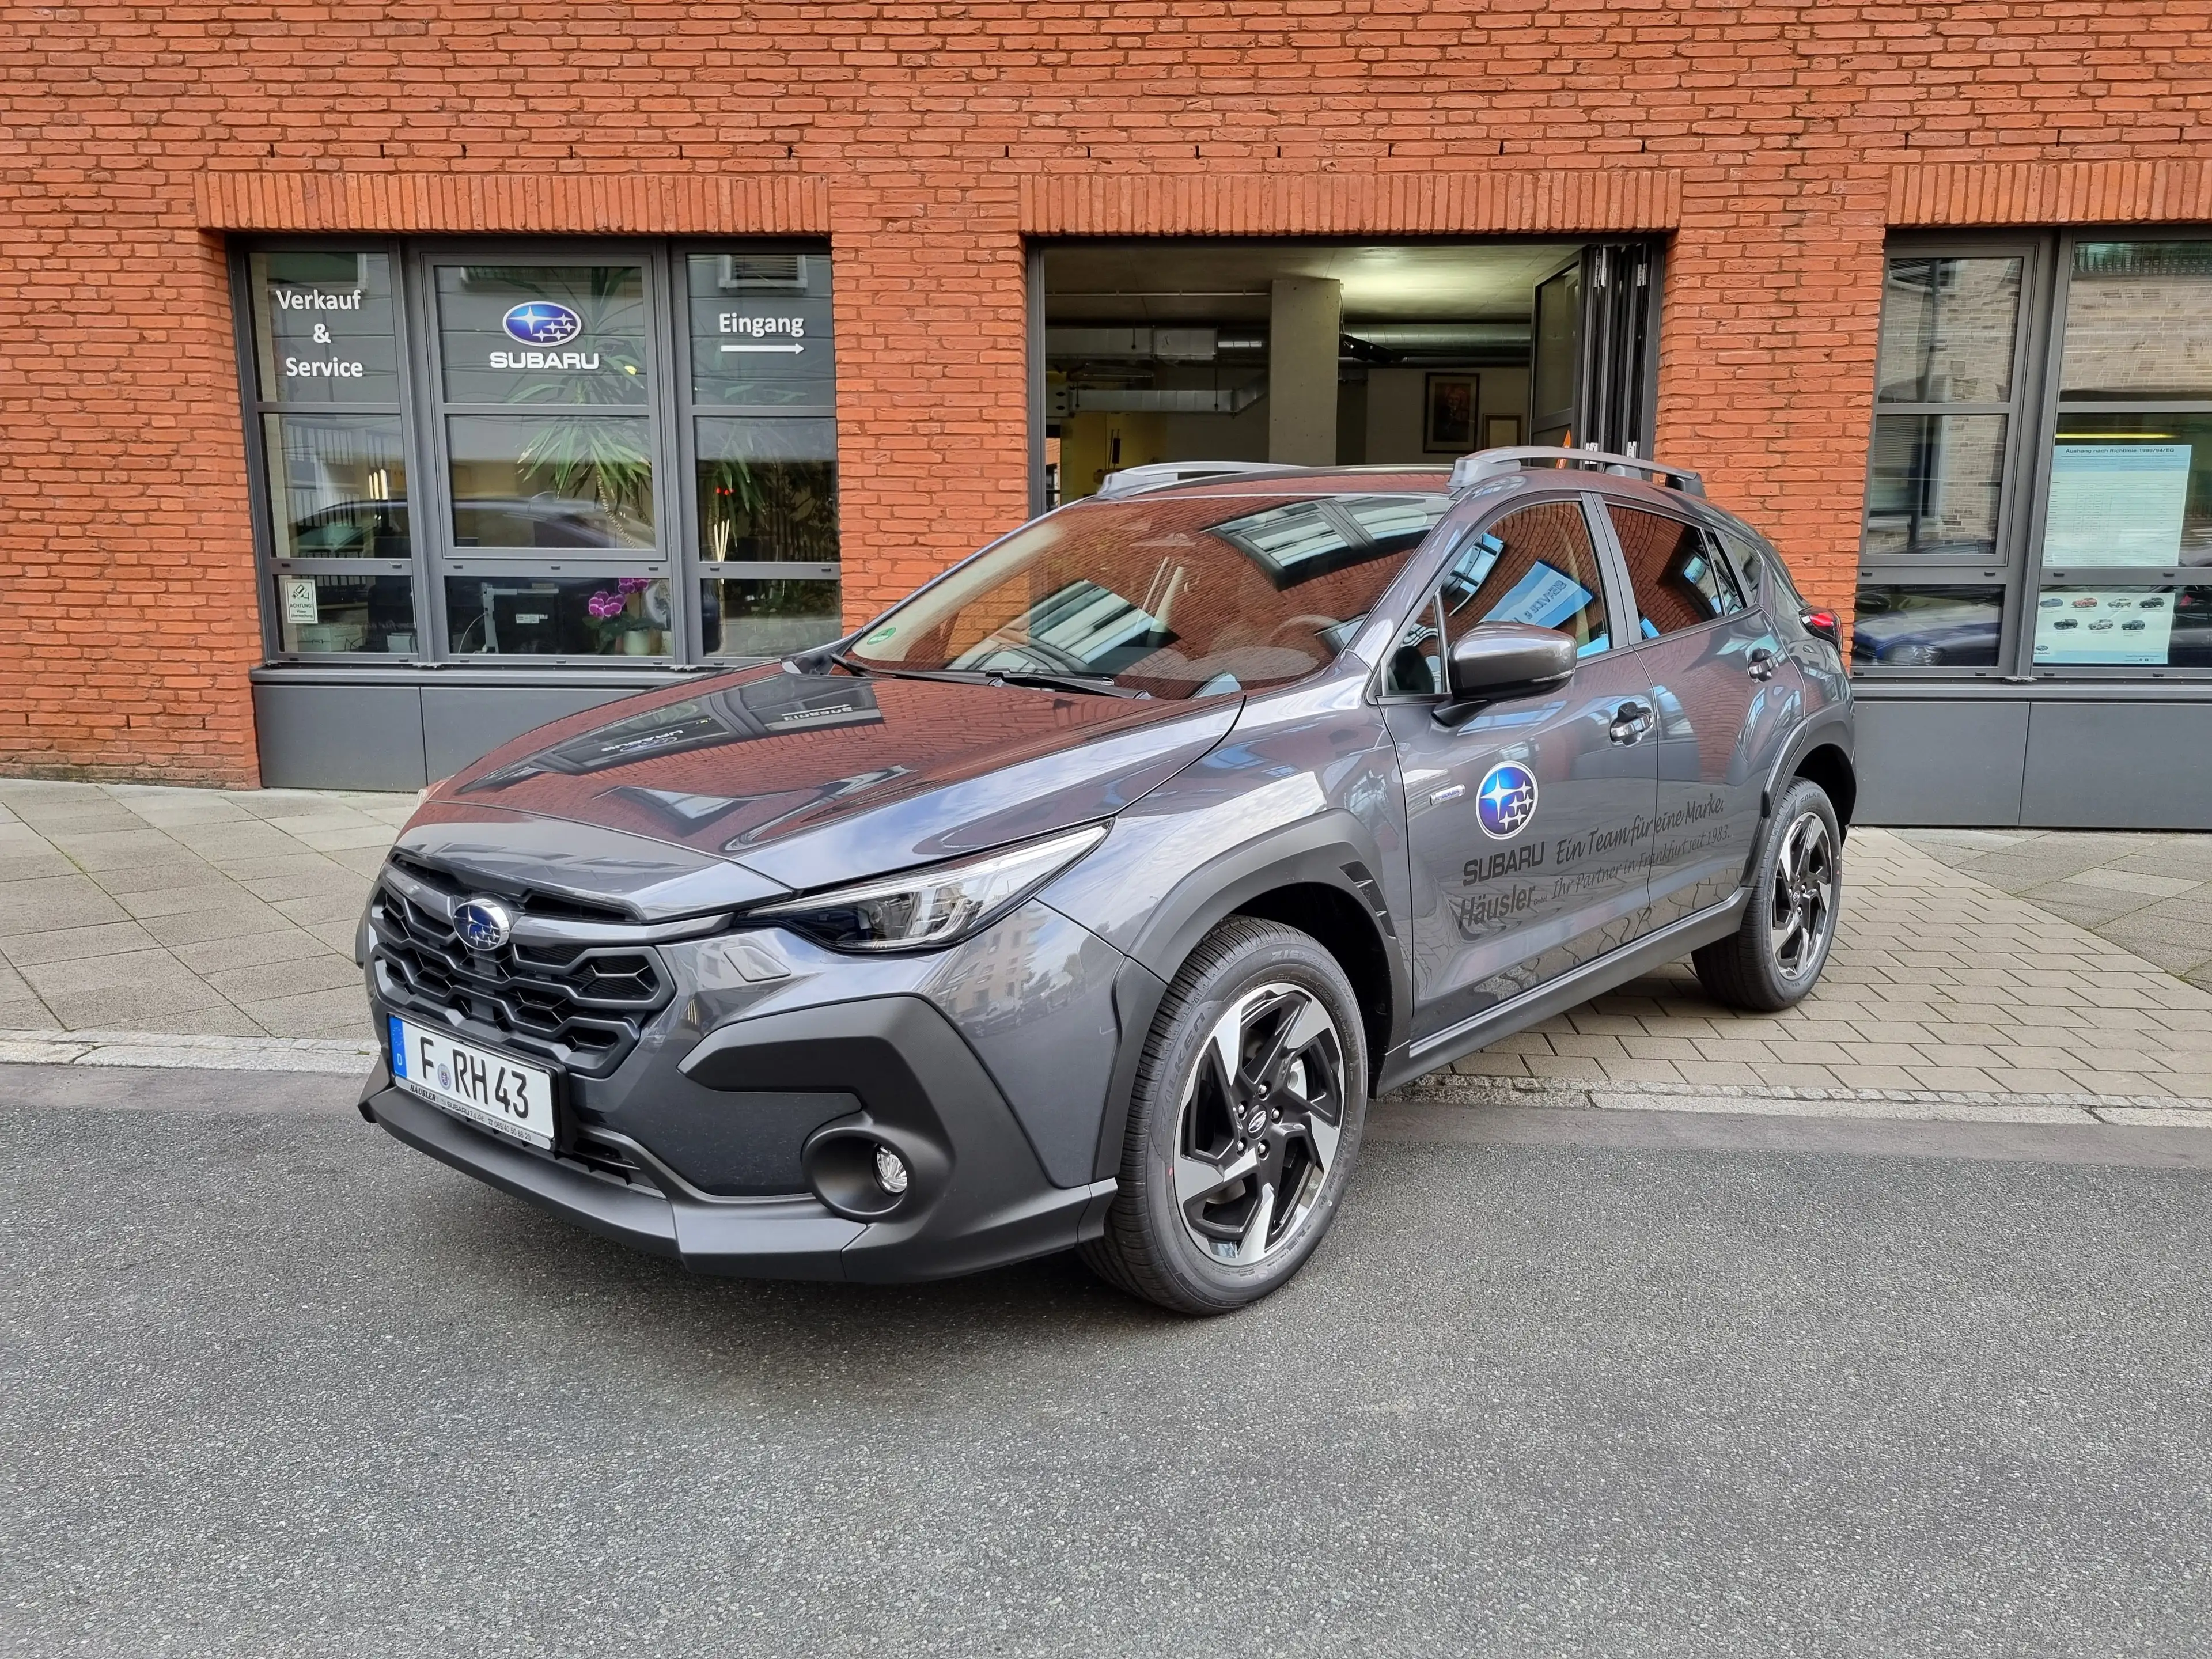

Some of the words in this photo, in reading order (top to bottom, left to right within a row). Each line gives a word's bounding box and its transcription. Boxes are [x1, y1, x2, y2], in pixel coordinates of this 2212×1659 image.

[276, 289, 361, 310] Verkauf
[313, 323, 331, 344] &
[719, 312, 804, 338] Eingang
[286, 357, 363, 378] Service
[490, 352, 600, 369] SUBARU
[1556, 838, 1586, 865] Ein
[1588, 827, 1630, 855] Team
[1630, 814, 1654, 847] für
[1655, 810, 1685, 834] eine
[1463, 841, 1545, 887] SUBARU
[1551, 877, 1574, 900] Ihr
[1576, 864, 1622, 892] Partner
[1624, 857, 1638, 874] in
[1638, 838, 1688, 872] Frankfurt
[1688, 831, 1706, 854] seit
[1458, 884, 1536, 930] Häusler
[397, 1052, 403, 1066] D
[420, 1036, 434, 1080] F
